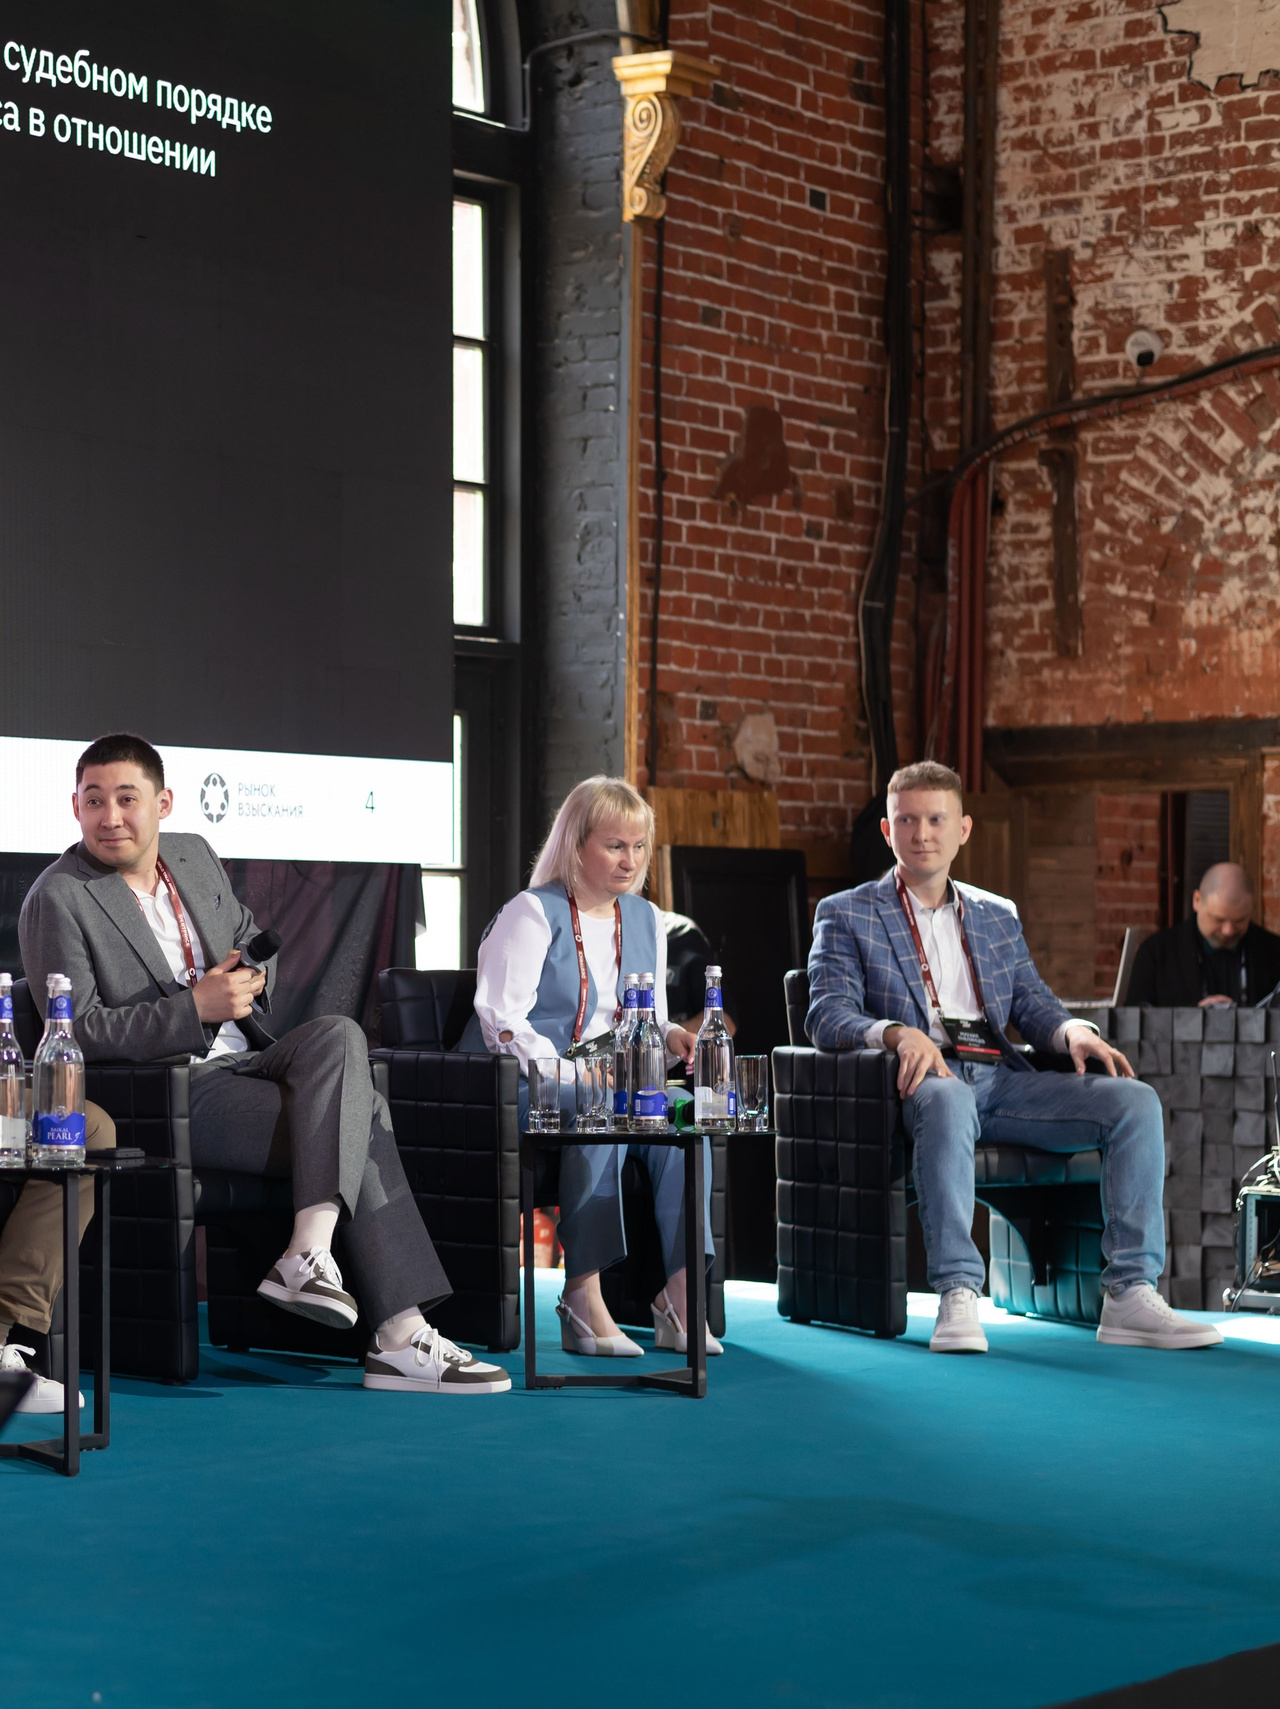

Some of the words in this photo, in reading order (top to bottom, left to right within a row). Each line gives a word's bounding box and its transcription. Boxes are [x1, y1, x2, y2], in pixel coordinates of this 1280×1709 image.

[4, 41, 147, 103] судебном
[156, 80, 272, 133] порядке
[28, 107, 46, 137] в
[54, 114, 216, 177] отношении
[238, 782, 276, 797] РЫНОК
[238, 802, 303, 818] ВЗЫСКАНИЯ
[365, 791, 375, 813] 4
[179, 914, 190, 947] DEBTPRICE
[47, 1132, 73, 1140] PEARL
